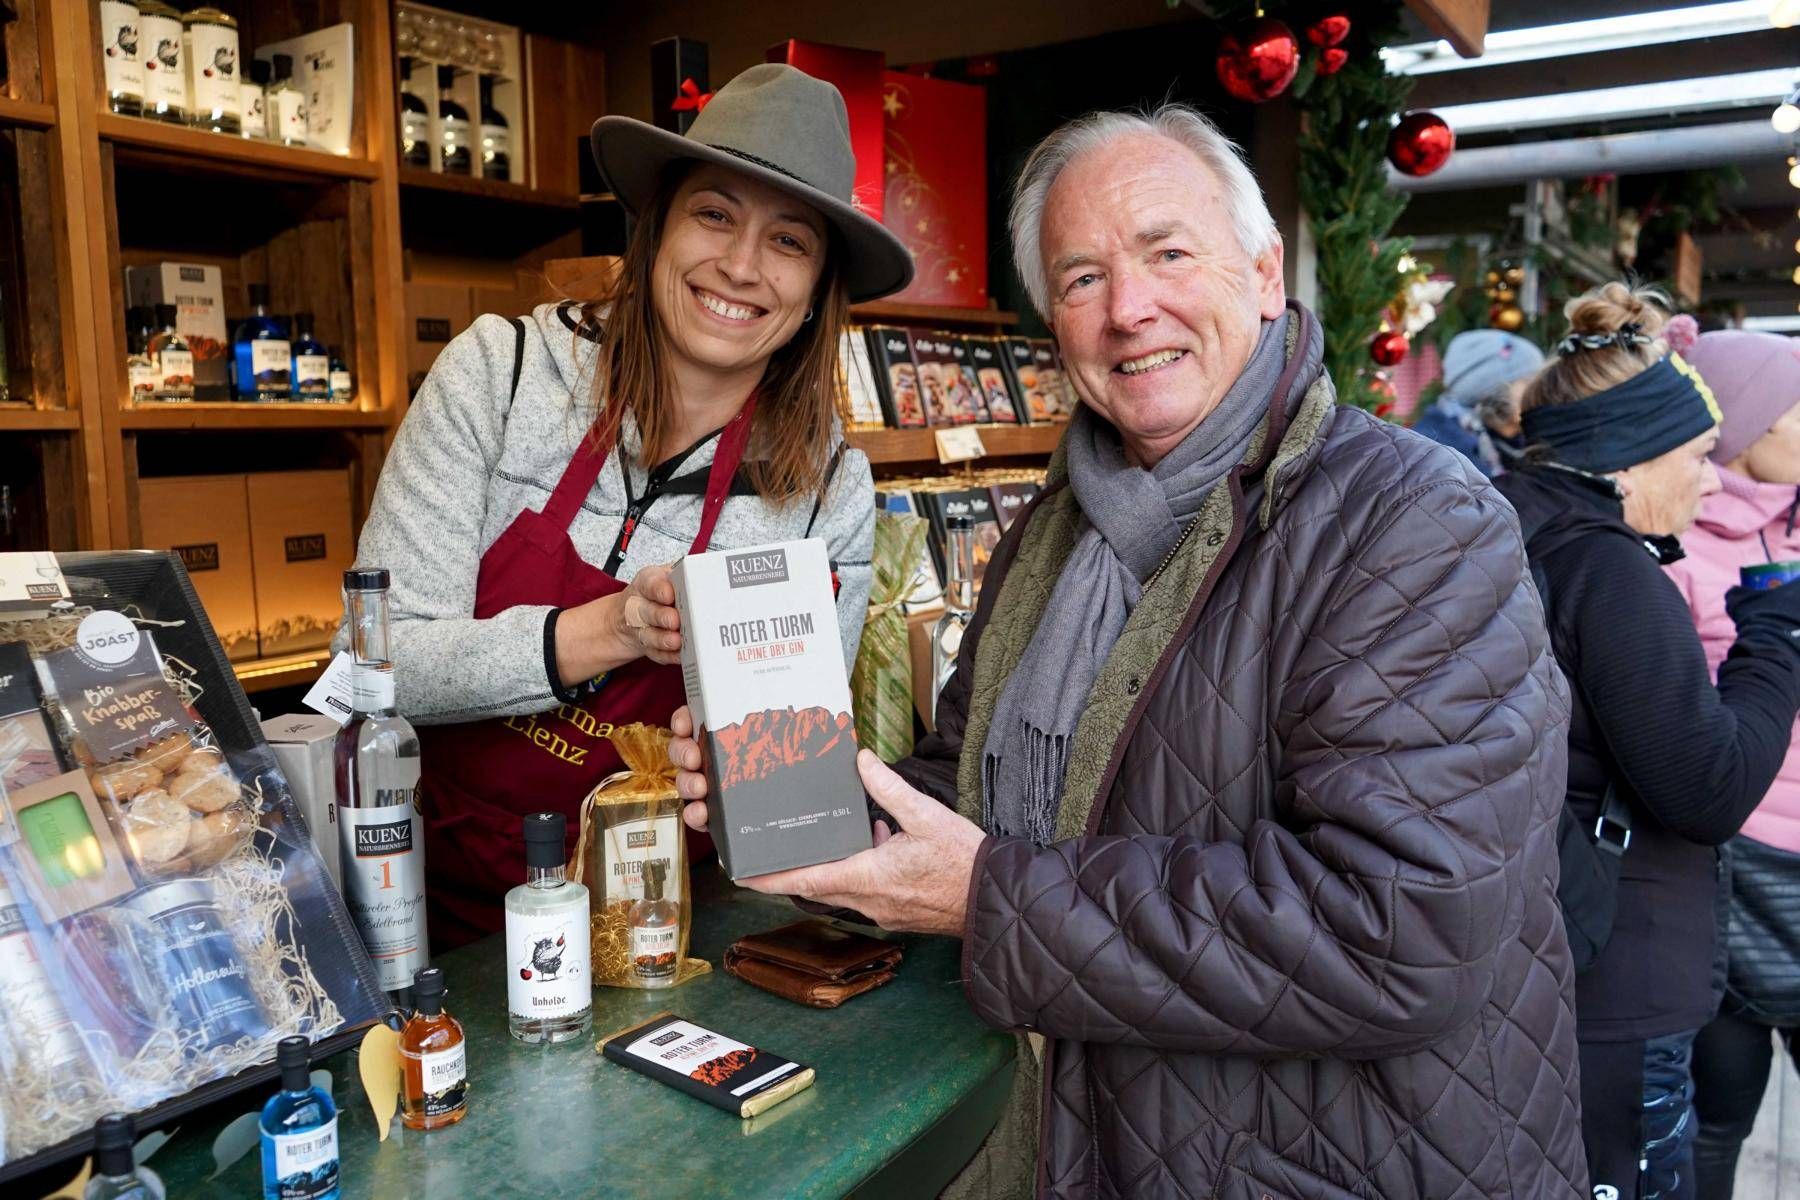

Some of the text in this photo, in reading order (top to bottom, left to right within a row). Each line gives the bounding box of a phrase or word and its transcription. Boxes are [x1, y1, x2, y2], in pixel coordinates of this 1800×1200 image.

[730, 554, 783, 575] KUENZ
[719, 612, 814, 647] ROTER TURM
[85, 631, 135, 650] JOAST
[737, 640, 805, 662] ALPINE DRY GIN
[84, 685, 114, 706] Bio
[82, 689, 162, 725] Knabber-
[503, 713, 589, 766] Lienz
[358, 825, 409, 844] KUENZ
[628, 832, 655, 842] KUENZ
[380, 860, 397, 889] 1
[613, 860, 643, 876] ROTER
[660, 1044, 693, 1060] ROTER
[687, 1034, 717, 1048] TURM
